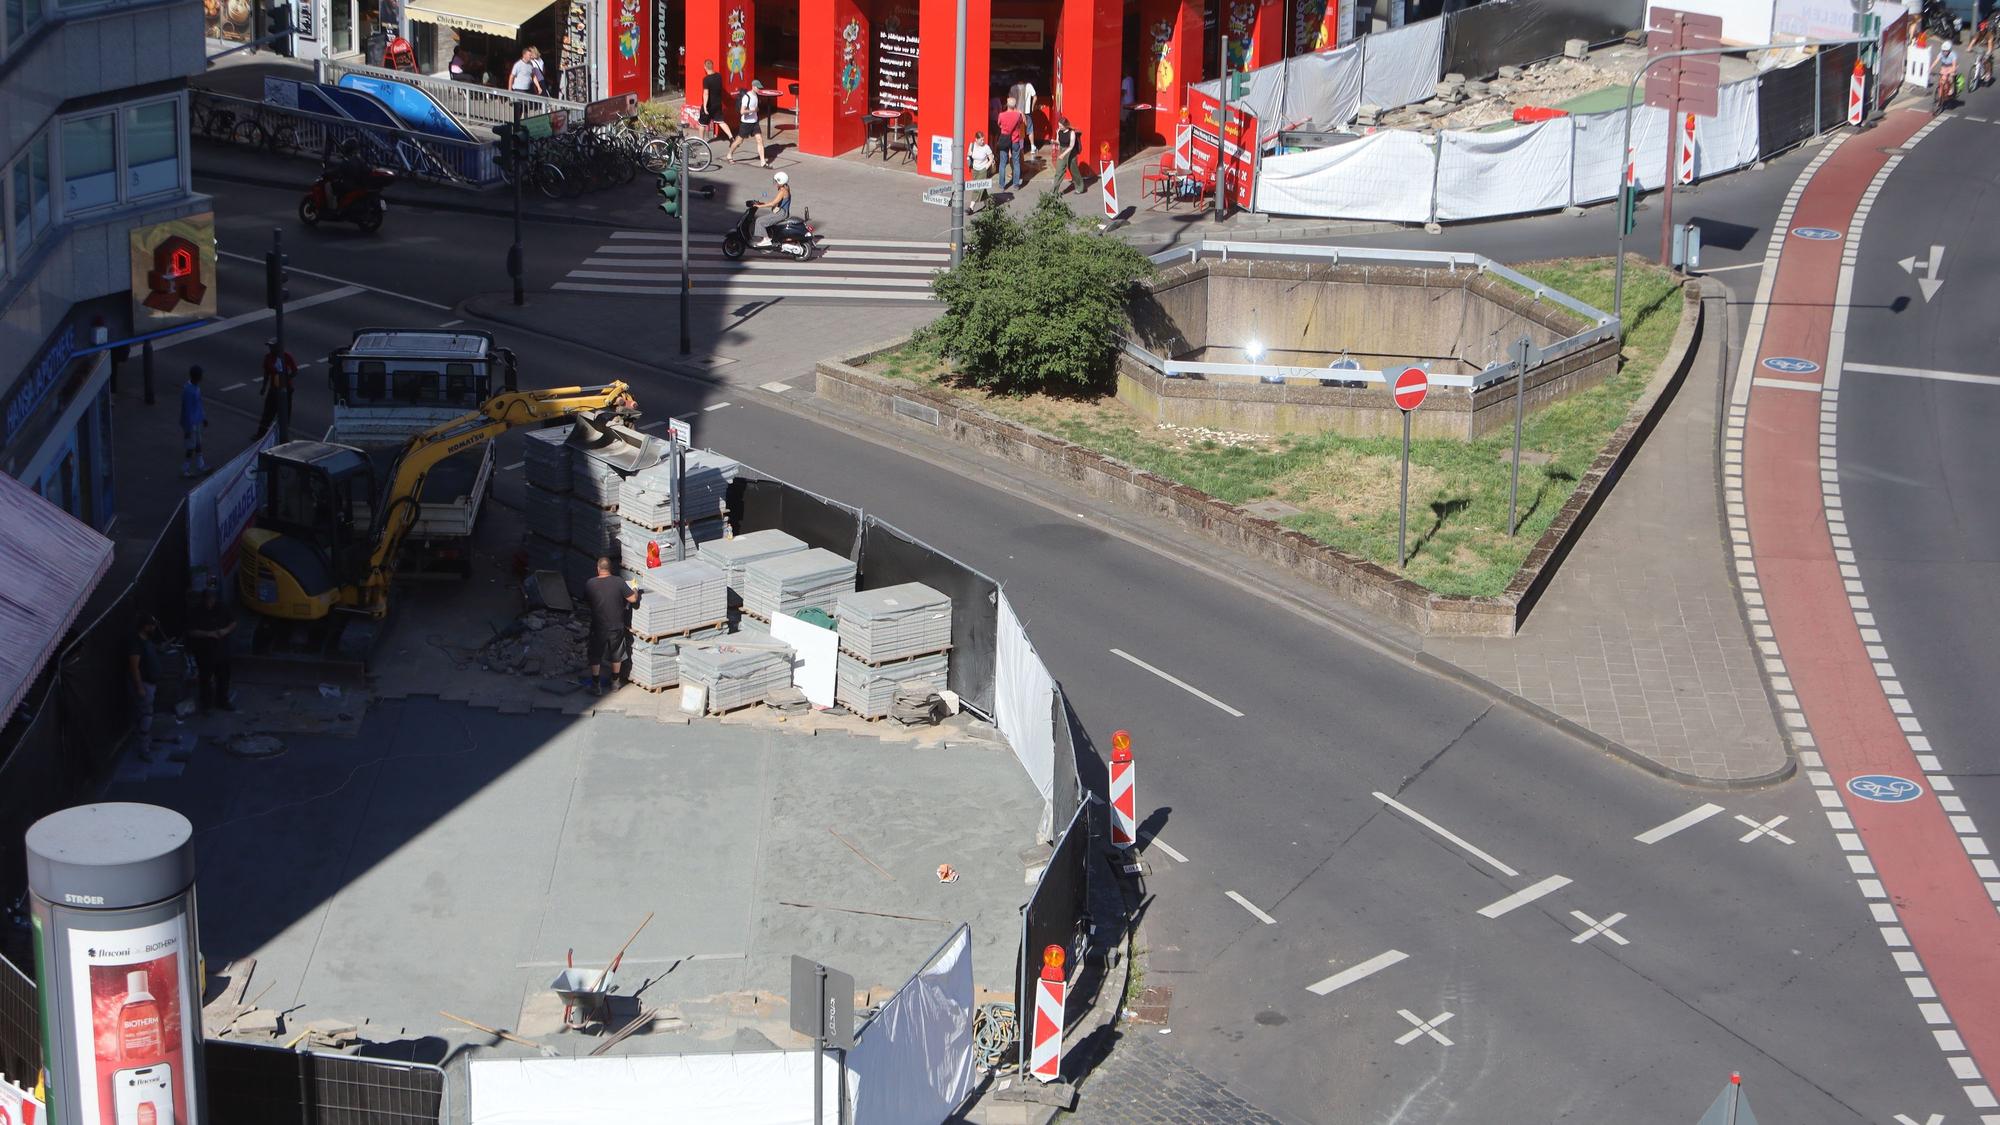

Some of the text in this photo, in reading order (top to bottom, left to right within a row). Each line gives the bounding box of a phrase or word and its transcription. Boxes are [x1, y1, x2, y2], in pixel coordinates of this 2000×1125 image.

[436, 15, 484, 30] Chicken Farm
[929, 185, 952, 196] Ebertplatz
[966, 180, 990, 190] Ebertplatz
[448, 431, 485, 454] KOMATSU
[65, 893, 104, 905] STRÖER
[98, 937, 177, 958] flaconi BIOTHERM
[124, 1017, 159, 1029] BIOTHERM
